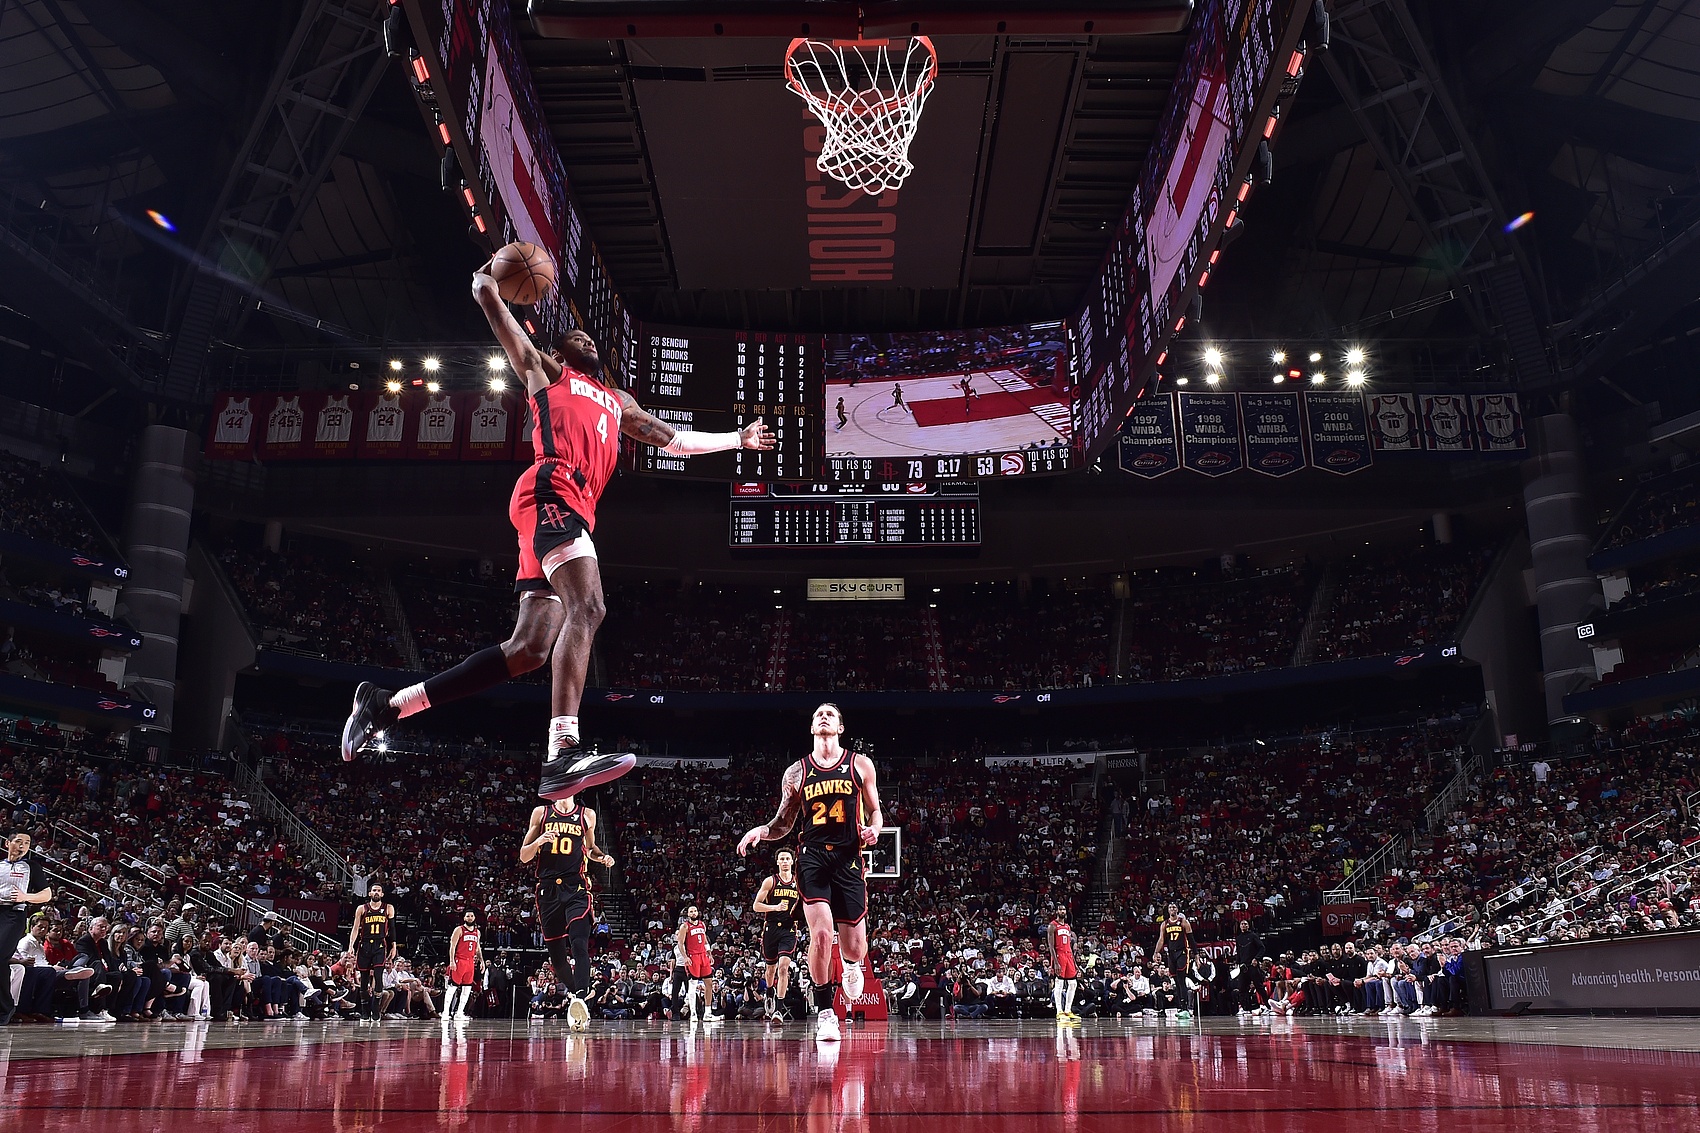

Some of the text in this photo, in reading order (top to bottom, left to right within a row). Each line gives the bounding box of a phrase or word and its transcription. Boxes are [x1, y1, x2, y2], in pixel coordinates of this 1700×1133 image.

[651, 336, 804, 355] 28 SENGUN 12 4 4 0
[652, 348, 804, 367] 9 BROOKS 10 0 2 2
[652, 360, 804, 379] 5 VANVLEET 10 3 1 2
[651, 372, 804, 391] 17 EASON 8 11 0 2
[651, 385, 803, 403] 4 GREEN 14 9 3 1
[322, 407, 349, 415] MURPHY
[373, 407, 403, 415] MALONE
[424, 407, 453, 417] DREXLER
[474, 408, 506, 417] OLAJUWON
[734, 404, 806, 415] PTS REB AST FLS
[226, 416, 243, 428] 44
[278, 415, 295, 427] 45
[327, 415, 343, 427] 23
[378, 414, 395, 427] 24
[429, 415, 445, 427] 22
[481, 415, 498, 427] 34
[659, 409, 693, 421] MATHEWS
[738, 415, 743, 425] 0
[778, 417, 783, 426] 0
[798, 418, 804, 427] 0
[1134, 415, 1158, 425] 1997
[1197, 414, 1221, 424] 1998
[1259, 414, 1284, 423] 1999
[1323, 413, 1349, 421] 2000
[597, 412, 608, 444] 4
[1131, 425, 1162, 435] WNBA
[1194, 424, 1225, 434] WNBA
[1256, 424, 1288, 434] WNBA
[1322, 422, 1353, 432] WNBA
[1387, 420, 1400, 429] 10
[1440, 420, 1452, 429] 14
[778, 429, 803, 439] 0 1
[1313, 433, 1365, 443] Champions
[1121, 435, 1173, 446] Champions
[1185, 435, 1237, 446] Champions
[1248, 435, 1298, 445] Champions
[778, 442, 803, 451] 7 1
[647, 446, 654, 456] 10
[737, 453, 742, 462] 8
[758, 454, 761, 463] 1
[777, 454, 783, 464] 0
[799, 455, 803, 464] 1
[1028, 448, 1069, 462] TOL FLS CC
[648, 458, 803, 477] 5 DANIELS 4 4 5 1
[831, 460, 872, 470] TOL FLS CC
[907, 460, 923, 479] 73
[937, 459, 961, 474] 8:17
[977, 457, 994, 476] 53
[1032, 459, 1067, 472] 5 3 1
[835, 470, 870, 480] 2 1 0
[830, 584, 856, 592] SKY
[860, 584, 902, 592] COURT
[1580, 627, 1592, 636] CC
[649, 695, 664, 704] Off
[1037, 694, 1051, 702] Off
[804, 780, 853, 800] HAWKS
[812, 799, 846, 826] 24
[544, 822, 582, 837] HAWKS
[551, 837, 573, 855] 10
[774, 888, 798, 898] HAWKS
[278, 907, 326, 923] TUNDRA
[365, 915, 386, 923] HAWKS
[370, 924, 380, 934] 11
[1169, 933, 1179, 941] 17
[1499, 966, 1548, 984] MEMORIAL
[1571, 967, 1700, 988] Advancing health. Persona
[1500, 982, 1551, 998] HERMANN
